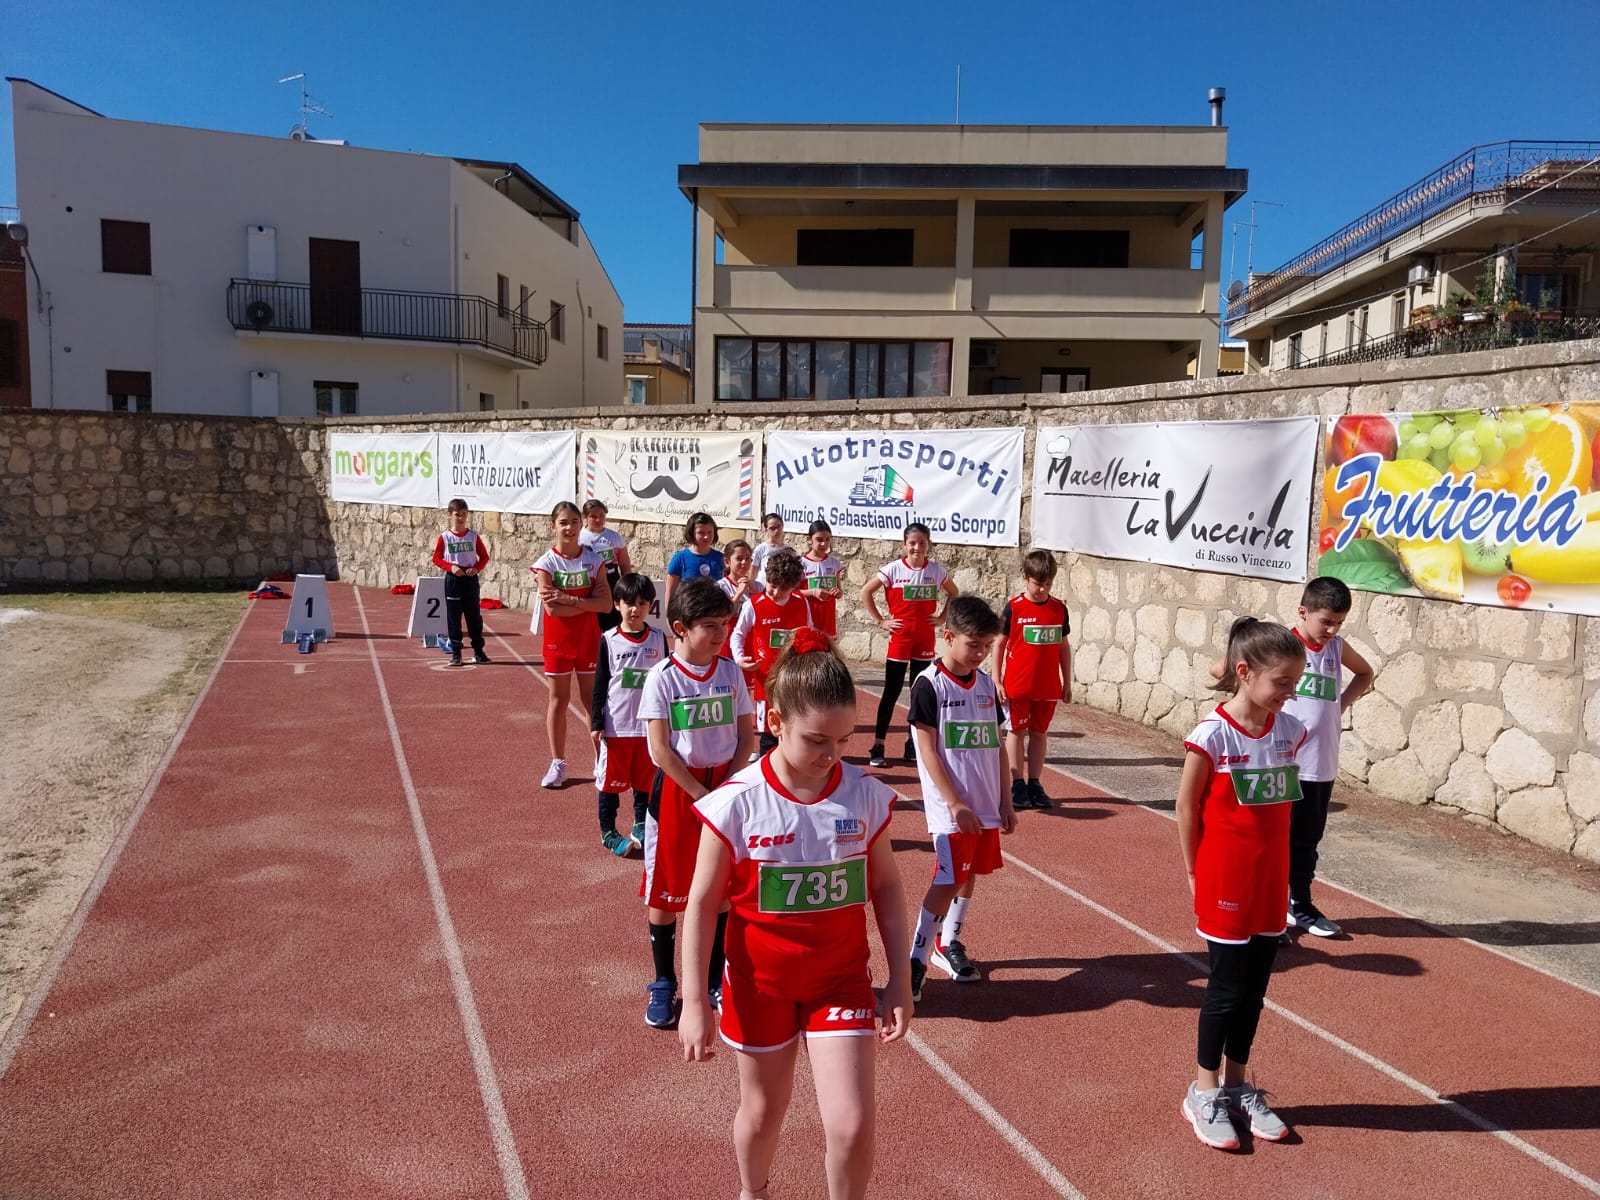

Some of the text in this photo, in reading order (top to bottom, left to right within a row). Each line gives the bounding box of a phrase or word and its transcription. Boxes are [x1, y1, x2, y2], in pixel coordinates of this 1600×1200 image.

[335, 450, 433, 485] morgan's
[629, 454, 701, 472] SHOP
[776, 437, 1008, 496] Autotrasporti
[1047, 455, 1161, 490] Macelleria
[452, 466, 541, 488] DISTRIBUZIONE
[1335, 454, 1585, 551] Frutteria
[775, 503, 814, 525] Nunzio
[829, 506, 902, 530] Sebastiano
[951, 512, 1006, 539] Scorpo
[1127, 500, 1160, 537] La
[1195, 549, 1292, 570] di Russo Vincenzo
[561, 574, 584, 587] 748
[814, 578, 833, 590] 745
[911, 587, 932, 599] 743
[304, 597, 313, 618] 1
[426, 598, 441, 618] 2
[1032, 628, 1056, 642] 749
[683, 700, 724, 726] 740
[956, 725, 990, 746] 736
[1243, 771, 1287, 800] 739
[747, 832, 796, 849] Zeus
[781, 868, 849, 906] 735
[826, 1007, 873, 1021] Zeus
